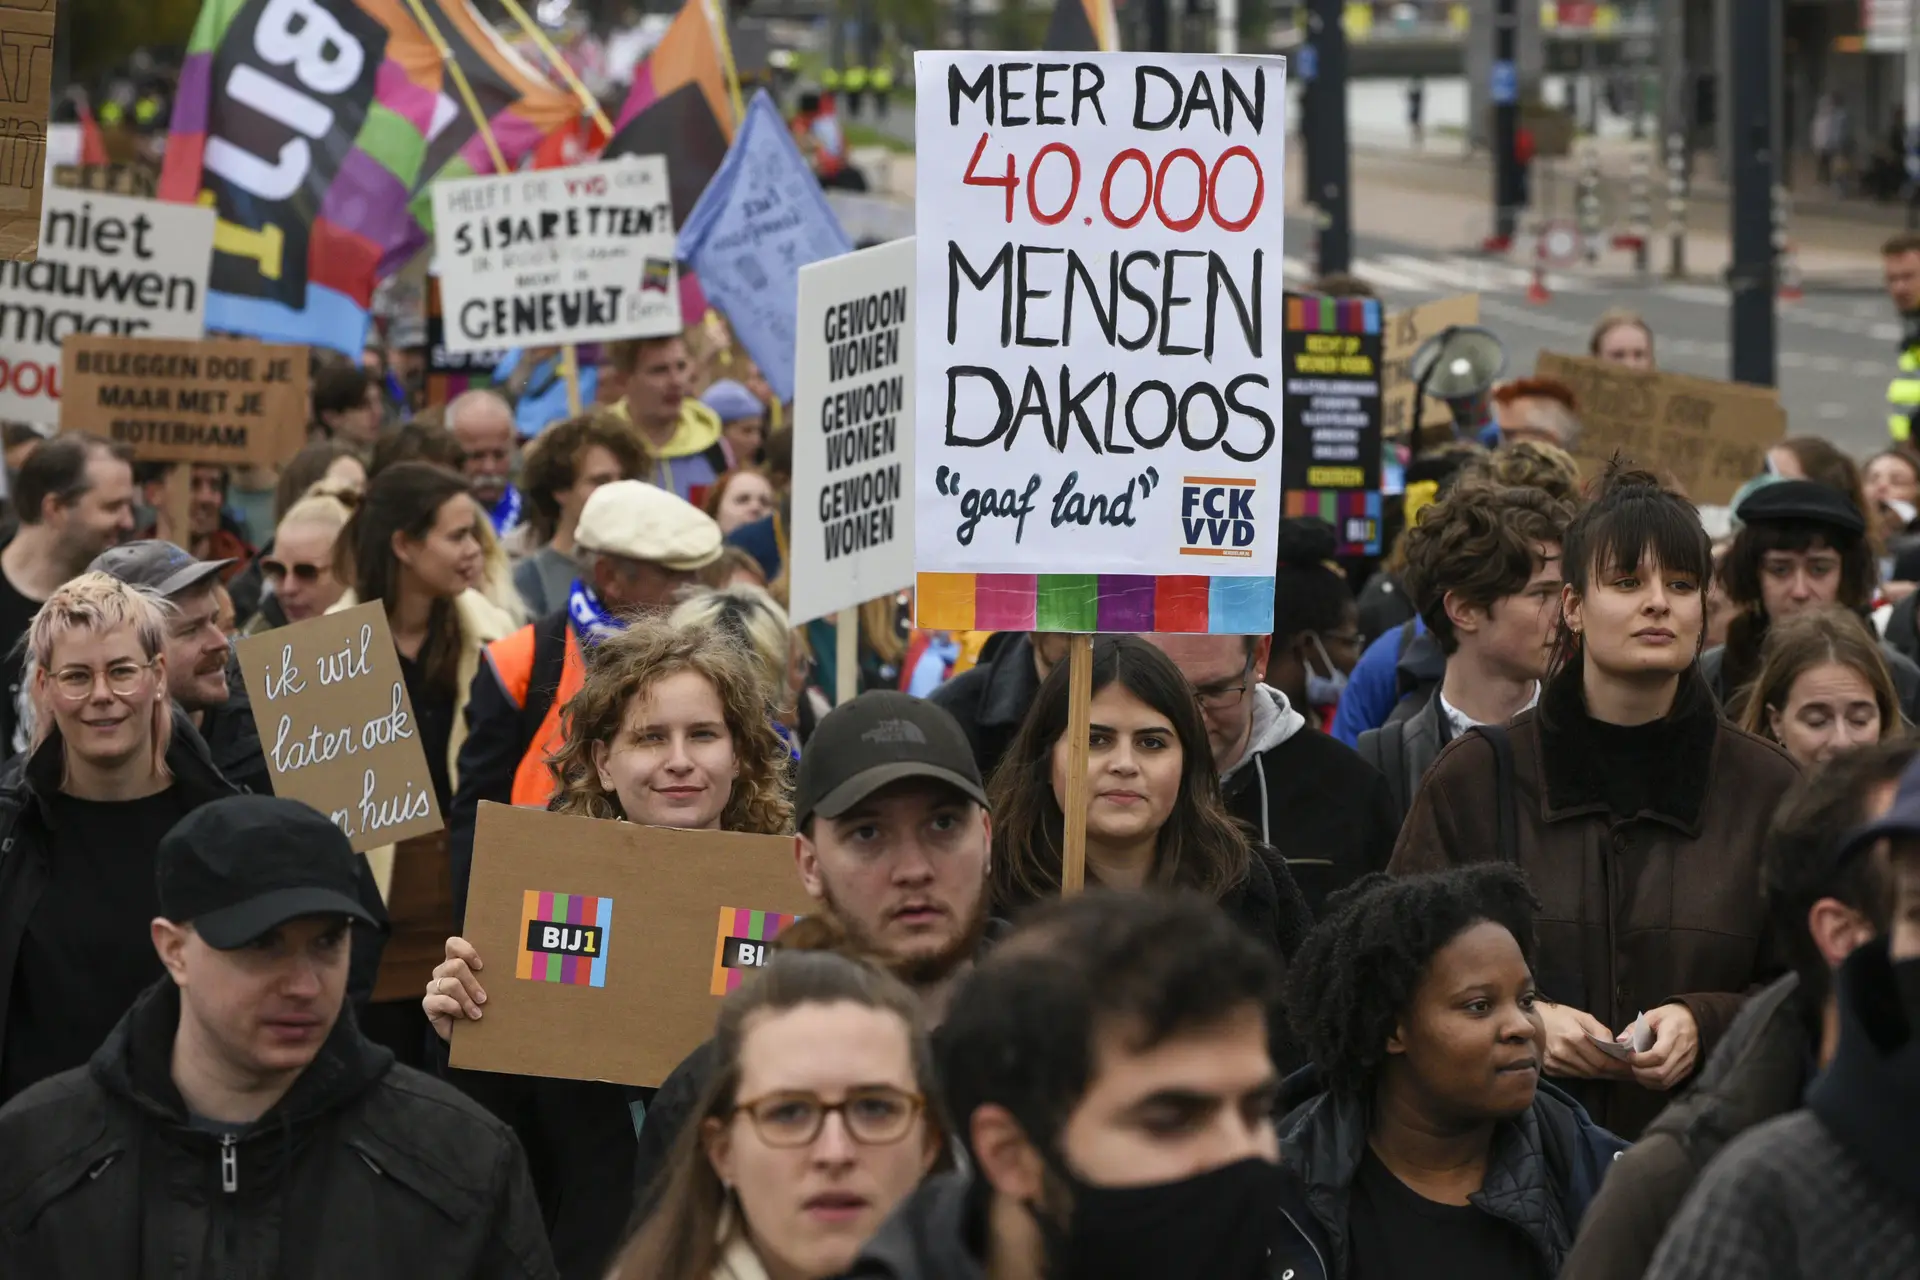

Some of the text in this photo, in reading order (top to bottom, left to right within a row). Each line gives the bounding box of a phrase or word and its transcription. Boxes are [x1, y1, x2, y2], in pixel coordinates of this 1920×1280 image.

[948, 62, 1265, 135] MEER DAN
[197, 0, 364, 280] BIJ1
[963, 132, 1264, 232] 40.000
[45, 203, 152, 259] niet
[824, 286, 906, 344] GEWOON
[947, 240, 1263, 364] MENSEN
[76, 351, 292, 383] BELEGGEN DOE JE
[829, 327, 899, 383] WONEN
[98, 385, 264, 417] MAAR MET JE
[821, 375, 903, 434] GEWOON
[945, 364, 1275, 462] DAKLOOS
[110, 419, 247, 447] BOTERHAM
[826, 416, 896, 472] WONEN
[819, 463, 901, 523] GEWOON
[1181, 486, 1255, 520] FCK
[824, 503, 894, 562] WONEN
[1181, 517, 1255, 546] VVD
[264, 624, 372, 700] ik wil
[270, 682, 413, 772] later ook
[358, 768, 430, 833] huis
[542, 926, 596, 953] BIJ1
[737, 943, 769, 967] BI
